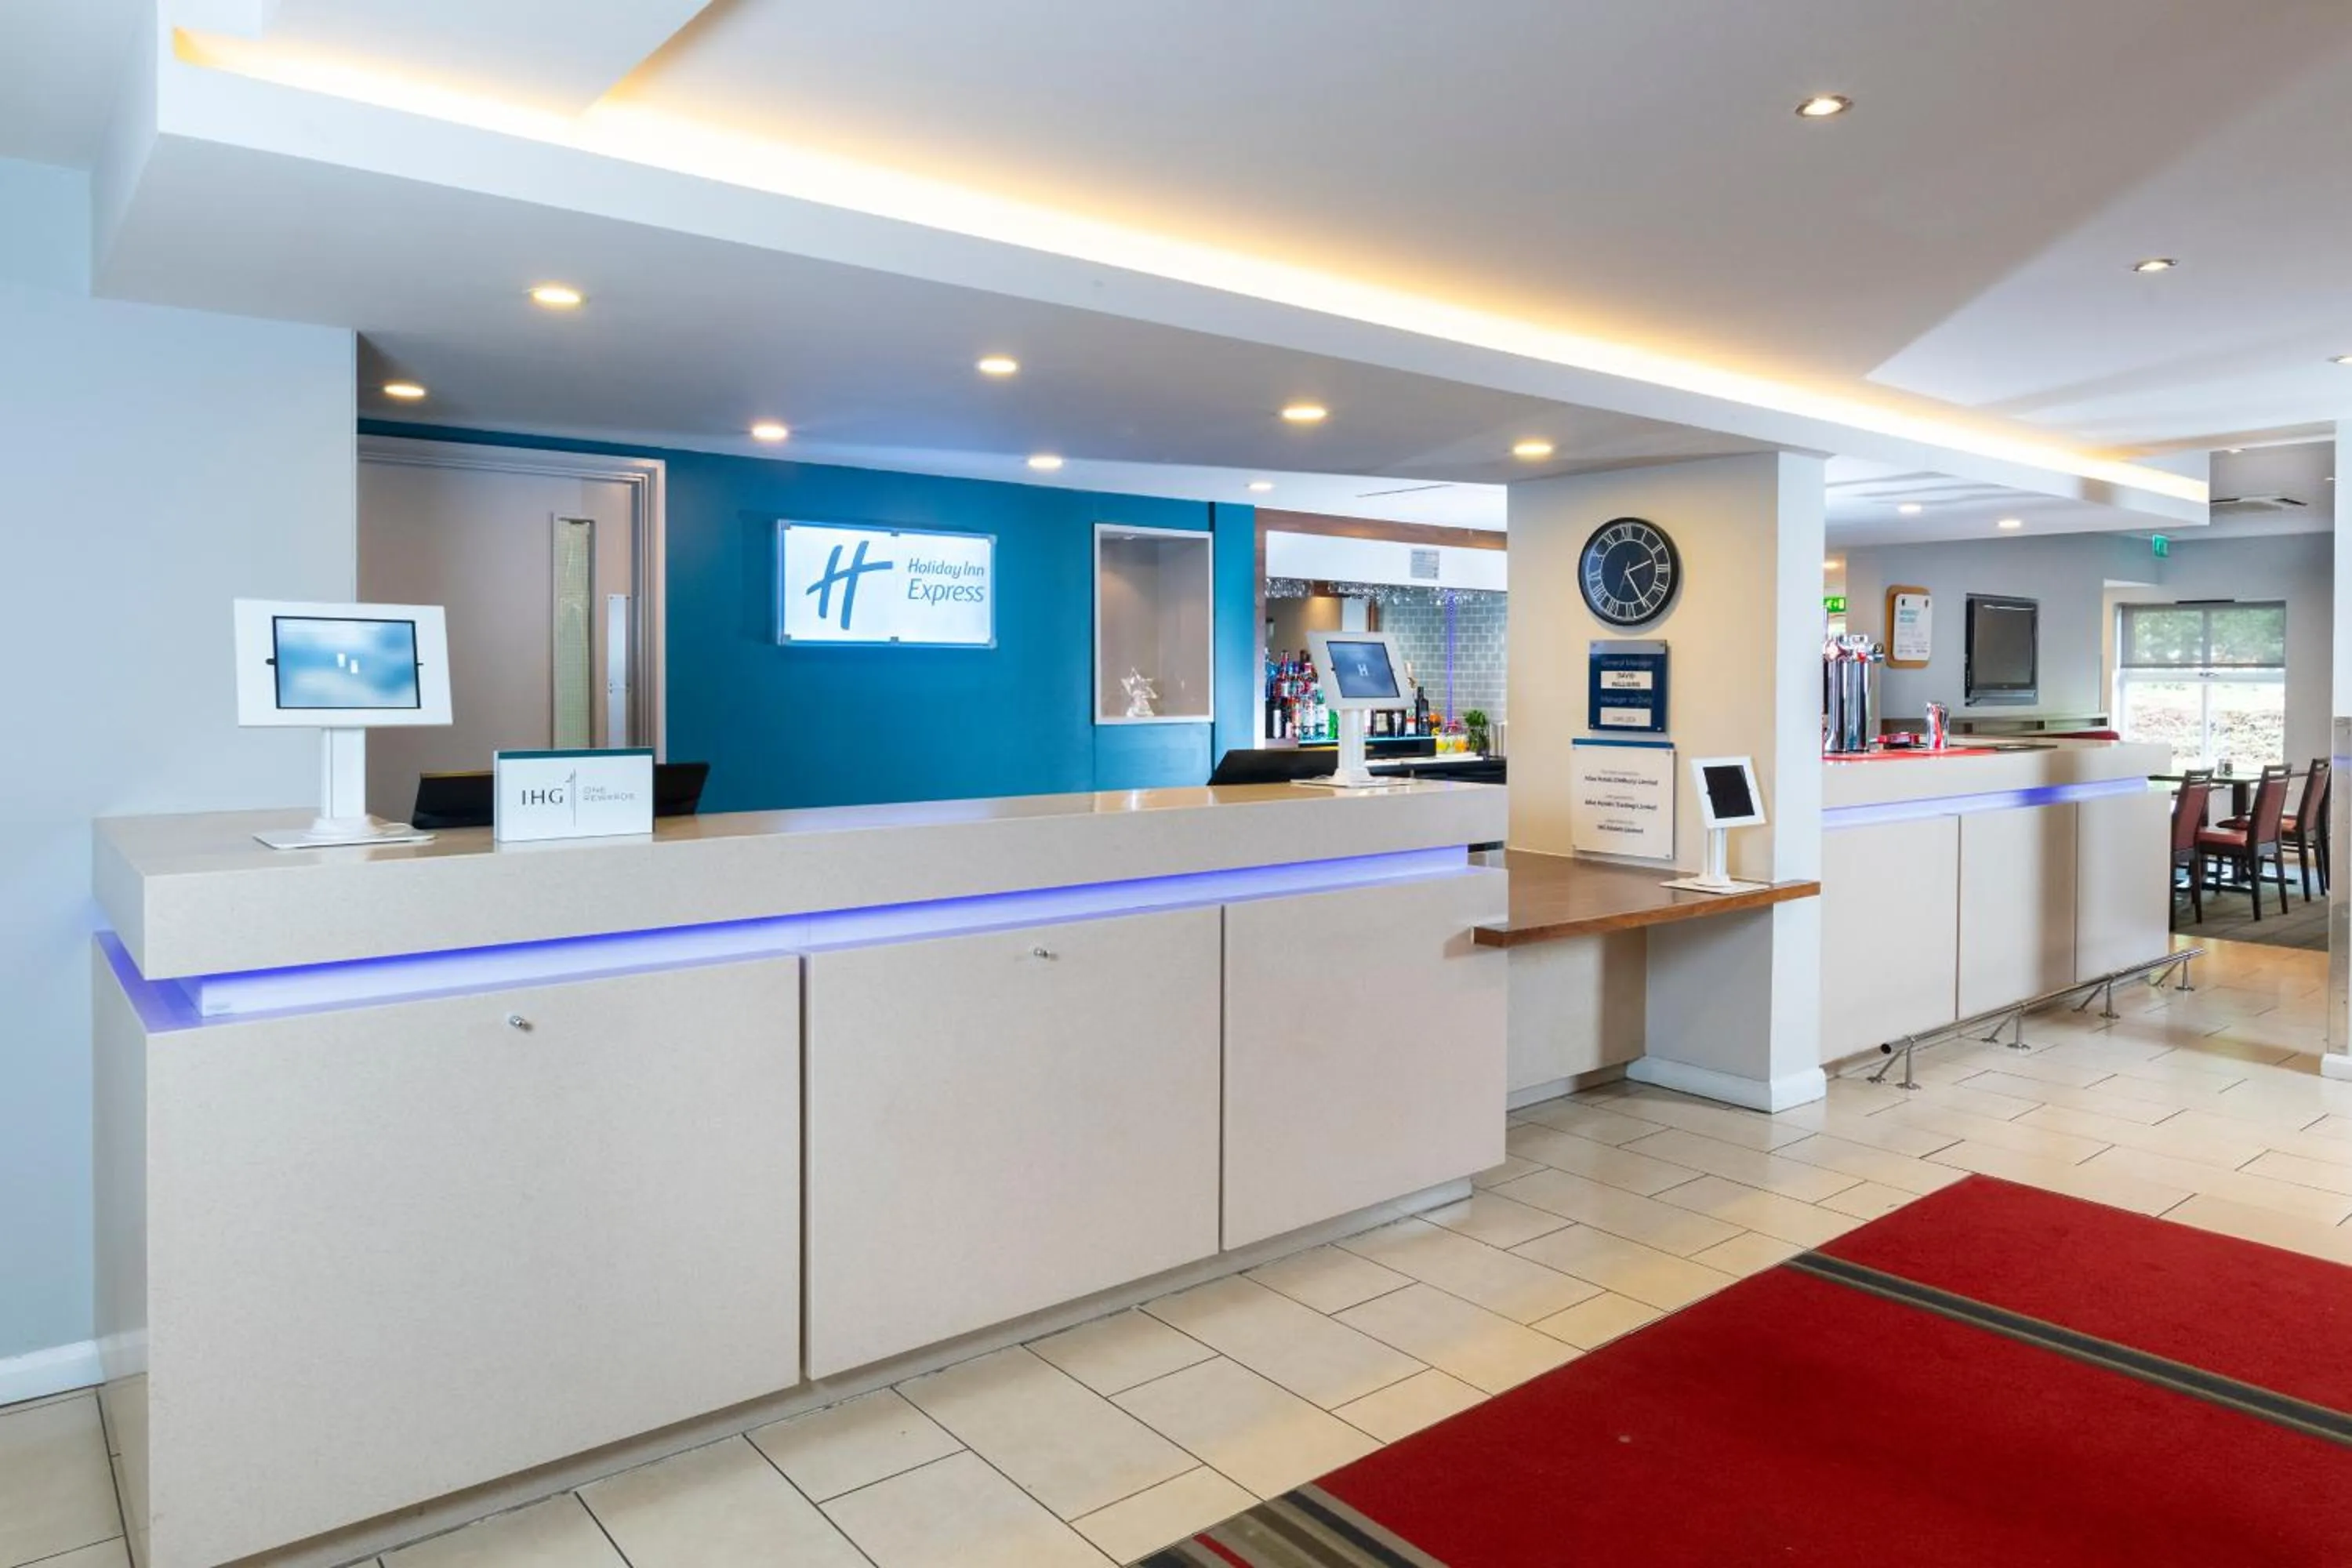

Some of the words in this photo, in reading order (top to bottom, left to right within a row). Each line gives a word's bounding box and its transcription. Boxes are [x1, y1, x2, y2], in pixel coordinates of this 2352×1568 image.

[908, 557, 963, 579] Holiday
[964, 561, 985, 577] Inn
[908, 578, 985, 606] Express
[521, 789, 564, 805] IHG
[583, 786, 606, 794] ONE
